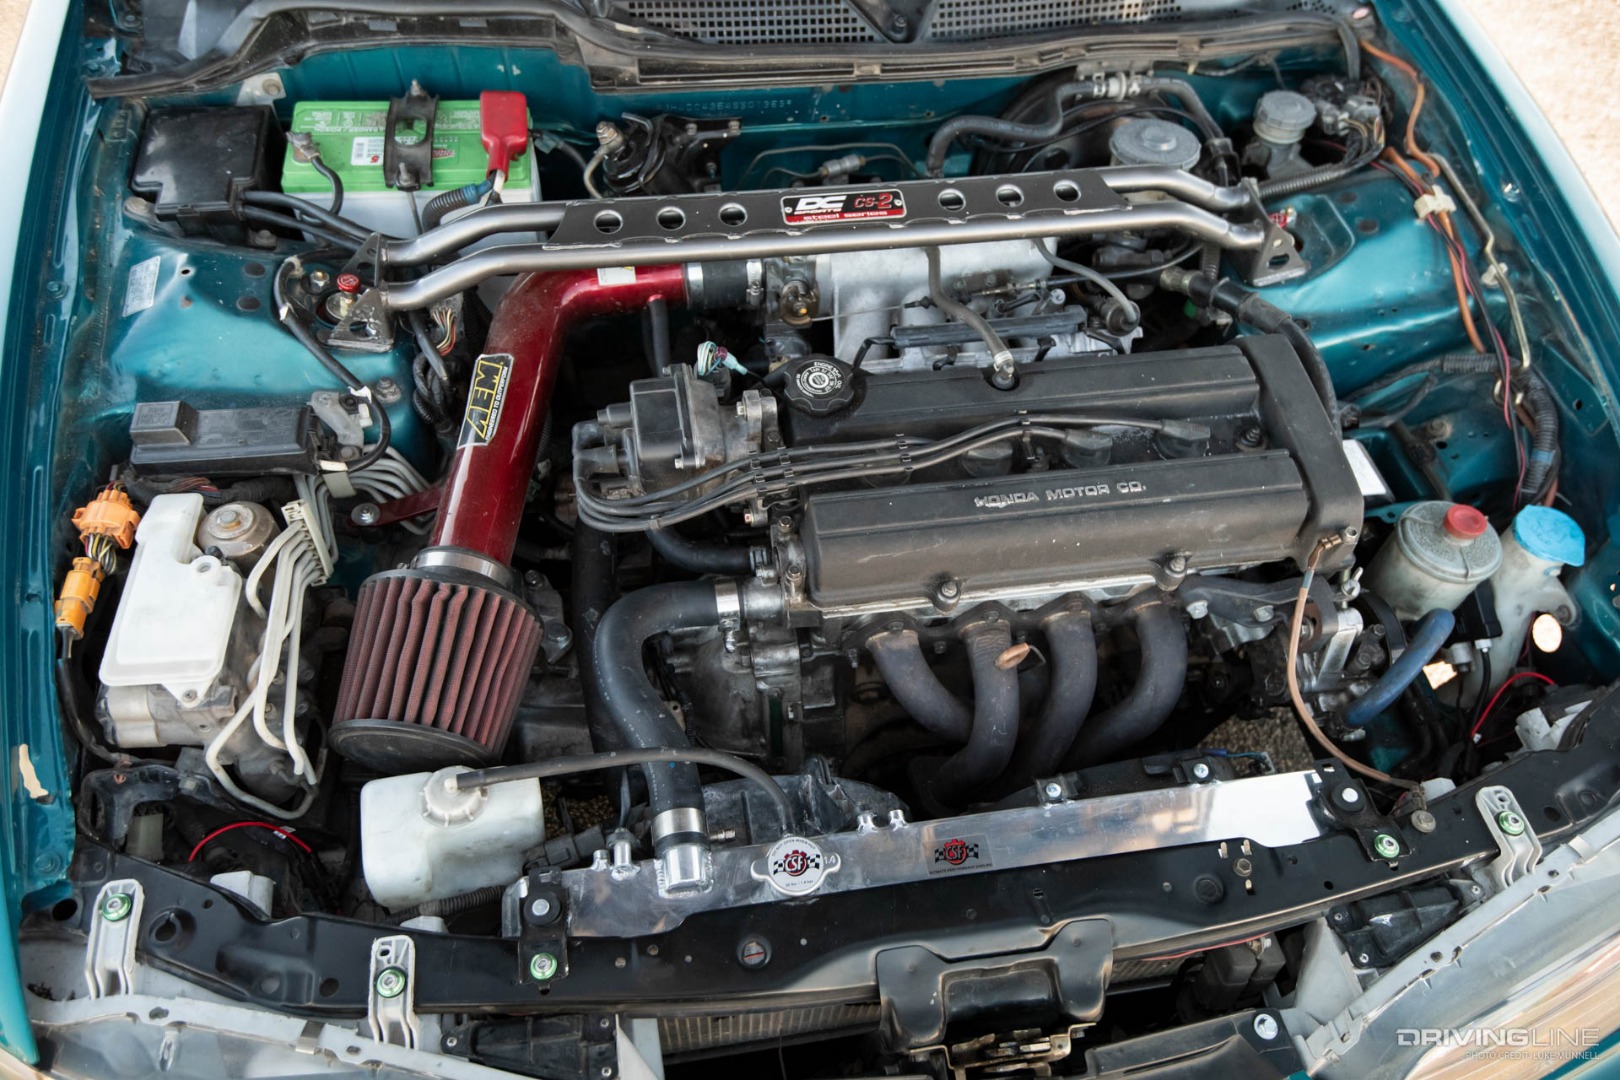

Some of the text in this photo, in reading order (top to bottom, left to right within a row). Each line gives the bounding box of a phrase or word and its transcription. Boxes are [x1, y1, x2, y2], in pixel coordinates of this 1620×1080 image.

[795, 195, 848, 211] DC
[803, 210, 888, 221] steel series
[495, 366, 508, 401] OUTPERFORM
[466, 360, 503, 439] AEM
[493, 400, 500, 408] TO
[974, 491, 1040, 508] HONDA
[1045, 483, 1110, 501] MOTOR
[946, 844, 963, 860] CSF
[785, 855, 804, 872] CSF
